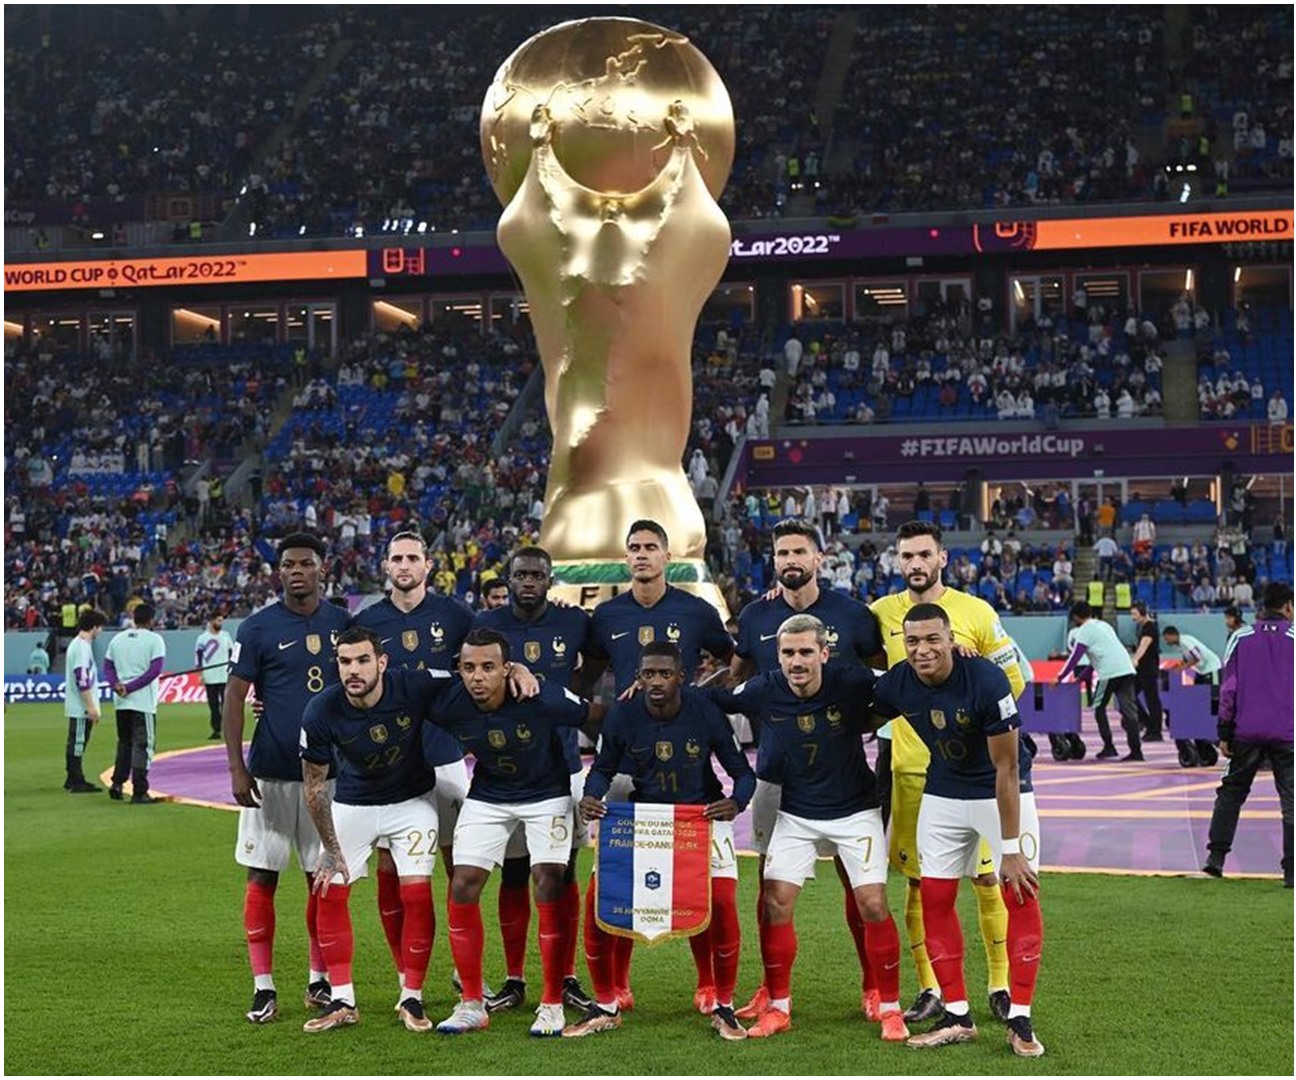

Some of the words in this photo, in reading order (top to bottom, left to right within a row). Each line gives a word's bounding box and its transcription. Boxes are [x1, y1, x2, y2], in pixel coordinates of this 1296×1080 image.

[1169, 222, 1212, 237] FIFA
[1215, 218, 1288, 234] WORLD
[5, 268, 67, 285] WORLD
[71, 267, 103, 283] CUP
[900, 435, 1085, 457] #FIFAWorldCup
[307, 665, 324, 693] 8
[364, 745, 401, 769] 22
[801, 743, 819, 766] 7
[936, 739, 968, 760] 10
[497, 755, 517, 774] 5
[655, 771, 679, 792] 11
[550, 815, 568, 842] 5
[407, 828, 438, 856] 22
[857, 836, 872, 863] 7
